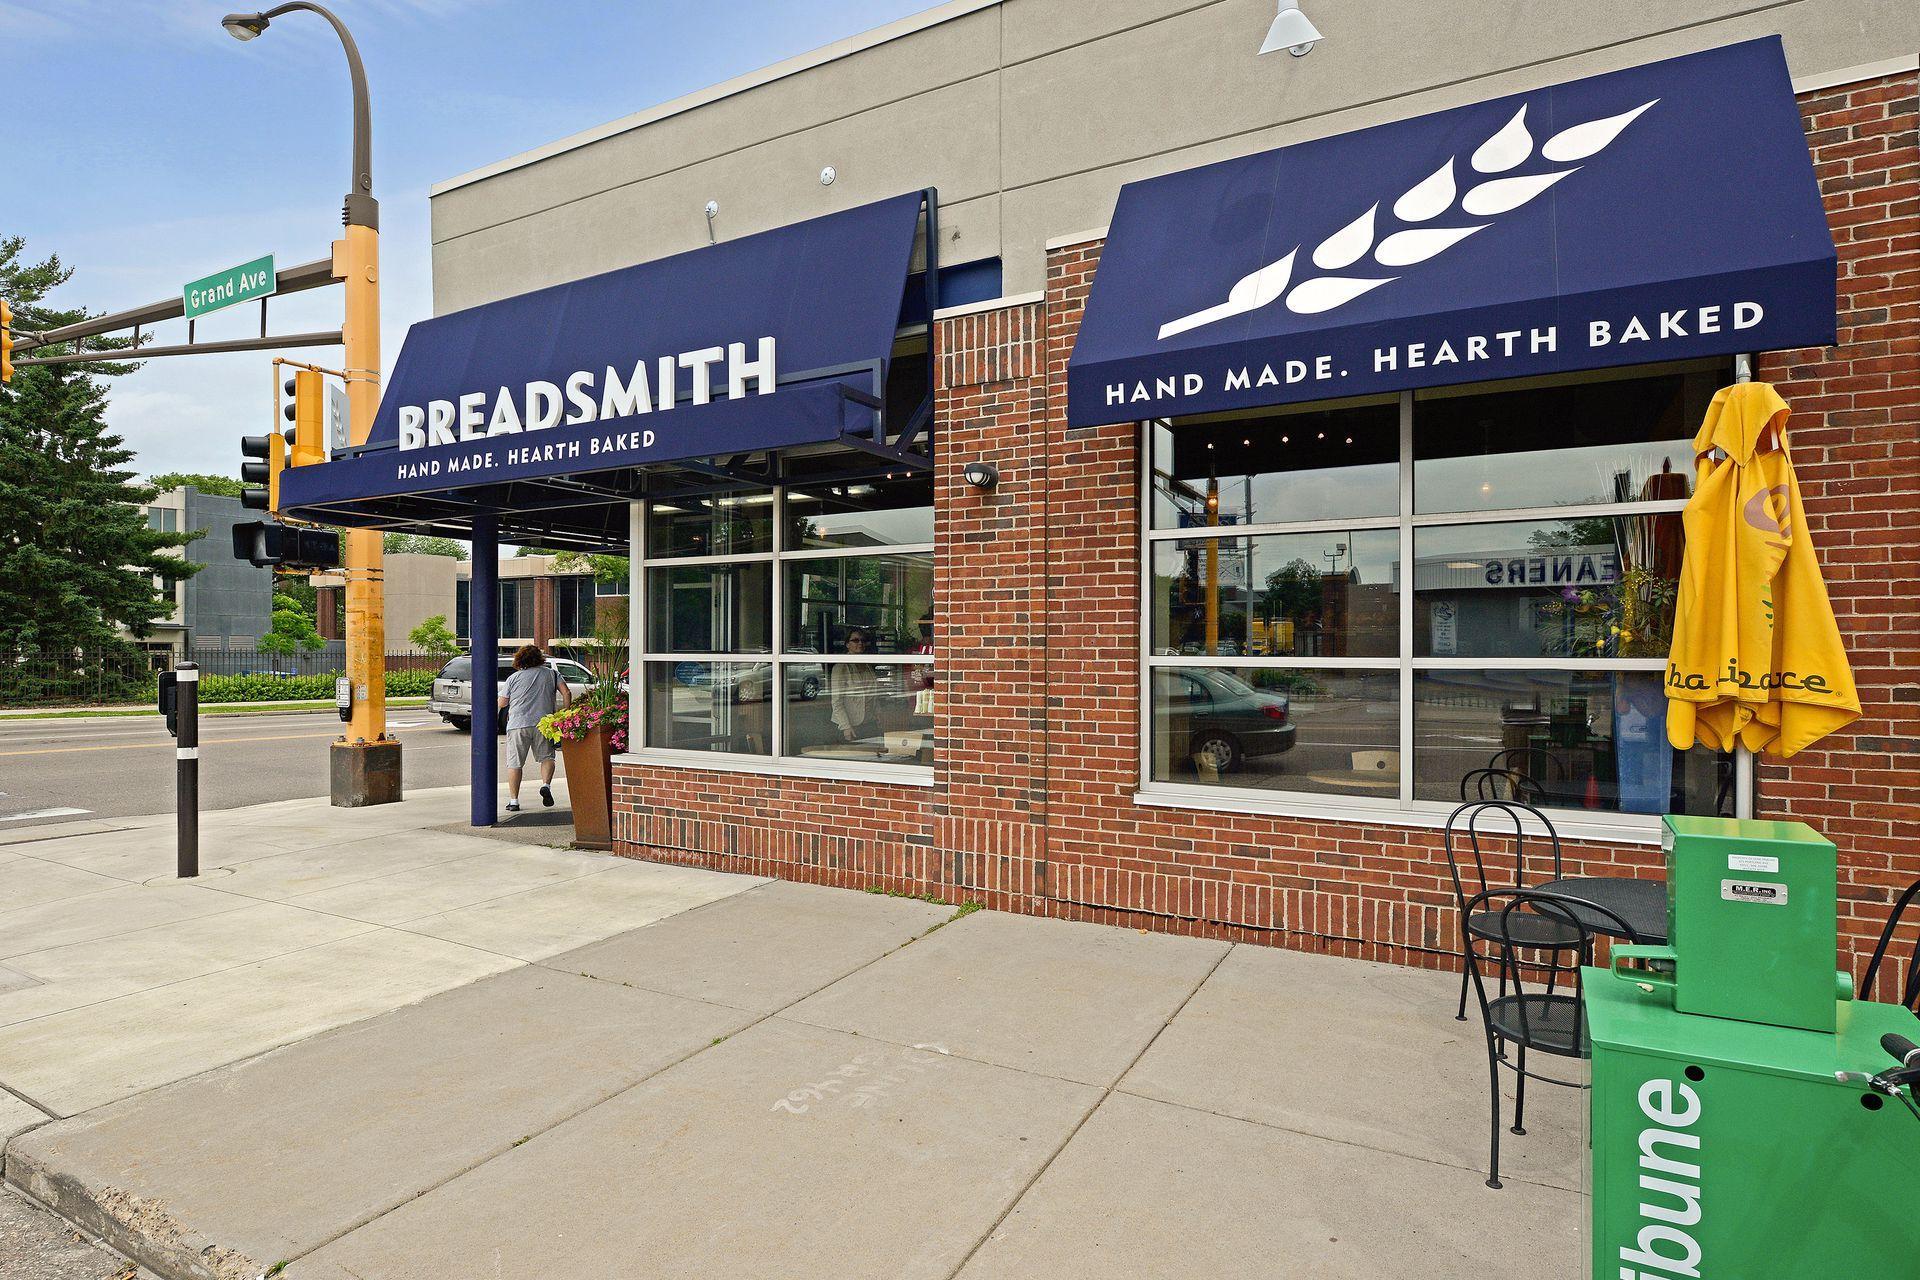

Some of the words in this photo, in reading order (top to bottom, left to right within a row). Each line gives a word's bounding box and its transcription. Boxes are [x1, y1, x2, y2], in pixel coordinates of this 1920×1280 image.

[191, 278, 233, 308] Grand
[239, 270, 267, 293] Ave
[1105, 373, 1204, 406] HAND
[1225, 354, 1349, 392] MADE.
[1374, 326, 1557, 373] HEARTH
[1589, 301, 1764, 347] BAKED
[398, 336, 775, 452] BREADSMITH
[397, 456, 441, 480] HAND
[448, 451, 499, 473] MADE.
[507, 438, 580, 465] HEARTH
[590, 430, 655, 455] BAKED
